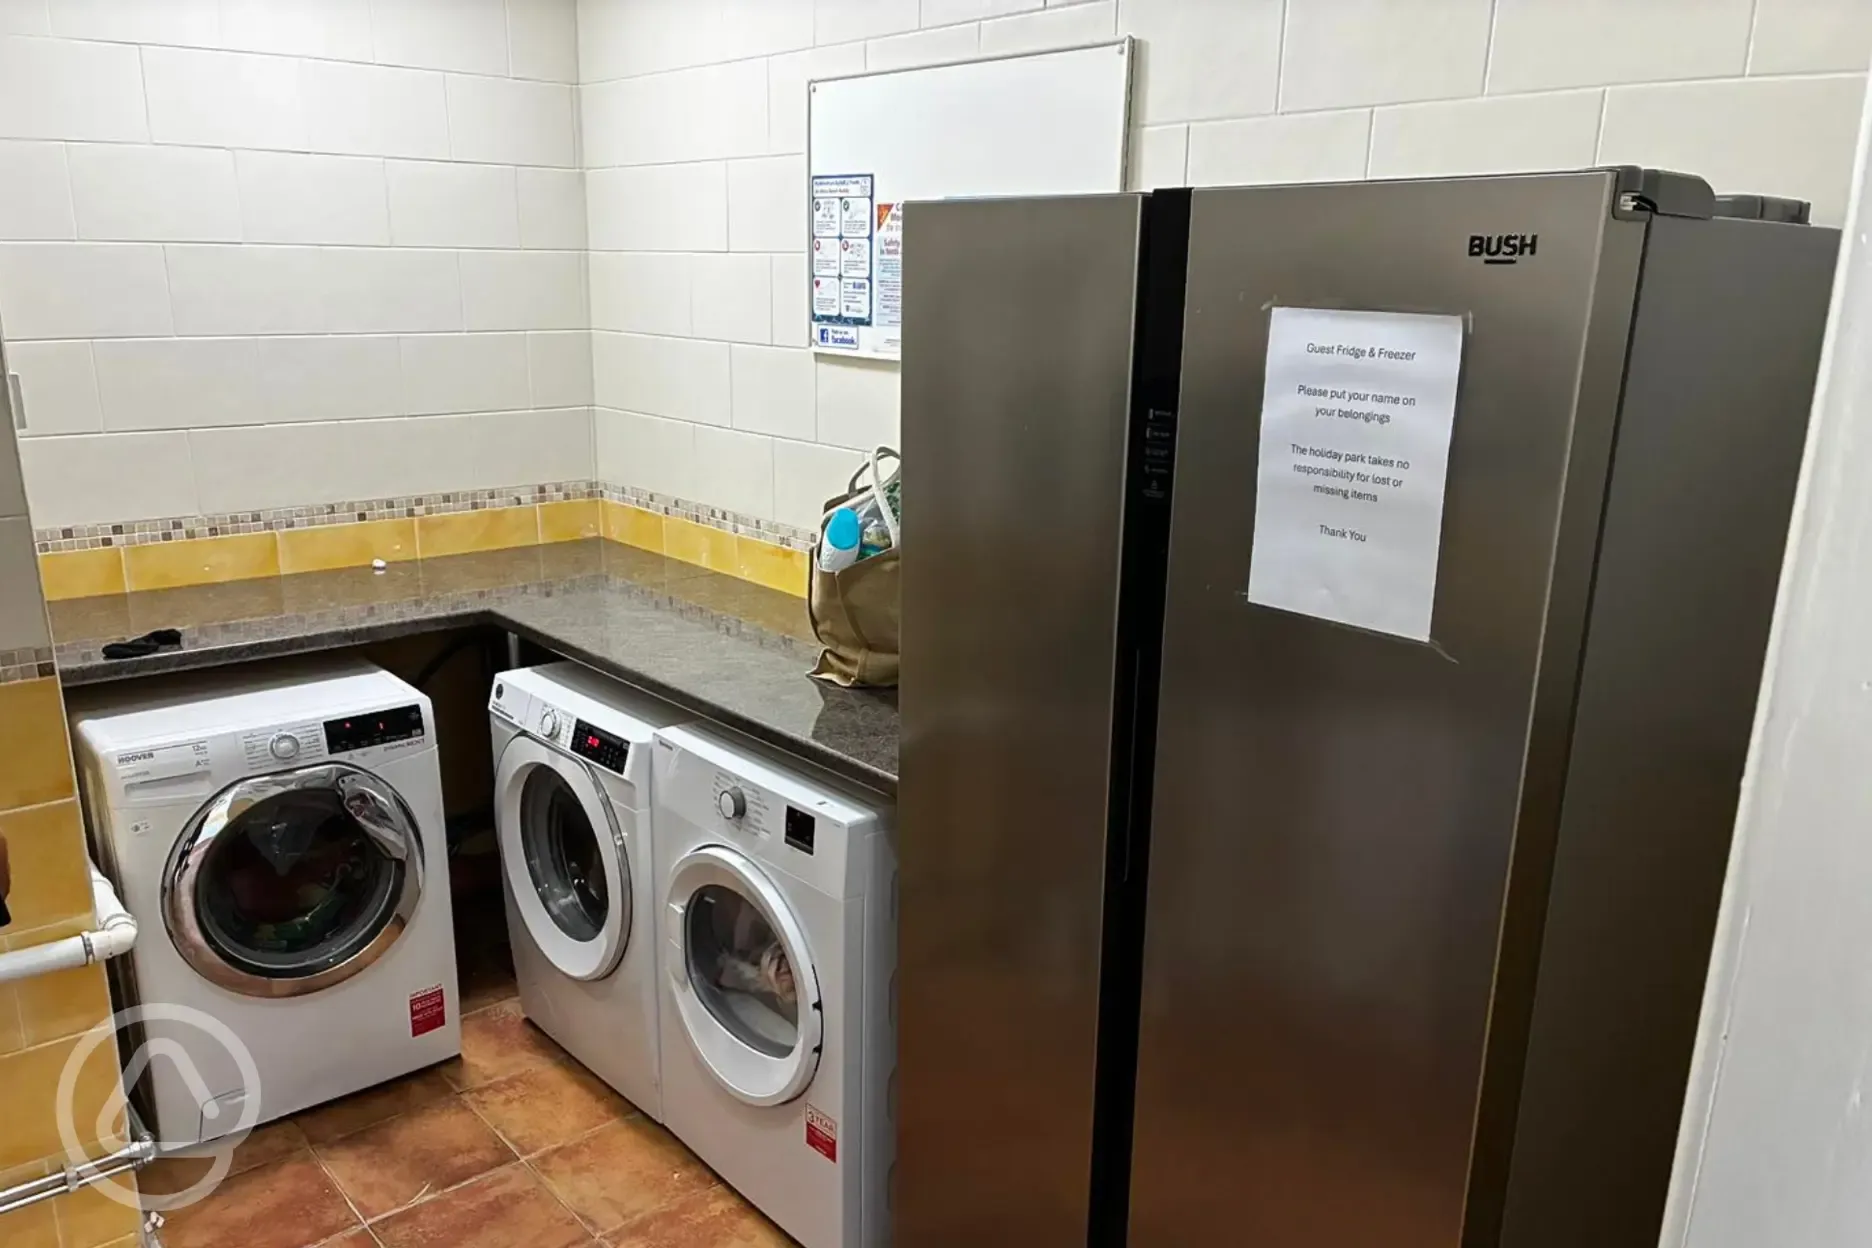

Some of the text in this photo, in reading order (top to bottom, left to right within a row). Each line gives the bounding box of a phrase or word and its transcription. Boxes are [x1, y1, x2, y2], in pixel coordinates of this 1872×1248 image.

[1468, 234, 1538, 257] BUSH
[1306, 342, 1417, 361] Guest Fridge & Freezer
[1297, 384, 1416, 407] Please put your name on
[1315, 406, 1391, 425] your belongings
[1291, 443, 1410, 470] The holiday park takes no
[1293, 463, 1404, 488] responsibility for lost or
[1313, 484, 1378, 503] missing items
[1319, 524, 1367, 542] Thank You
[117, 751, 155, 764] HOOVER
